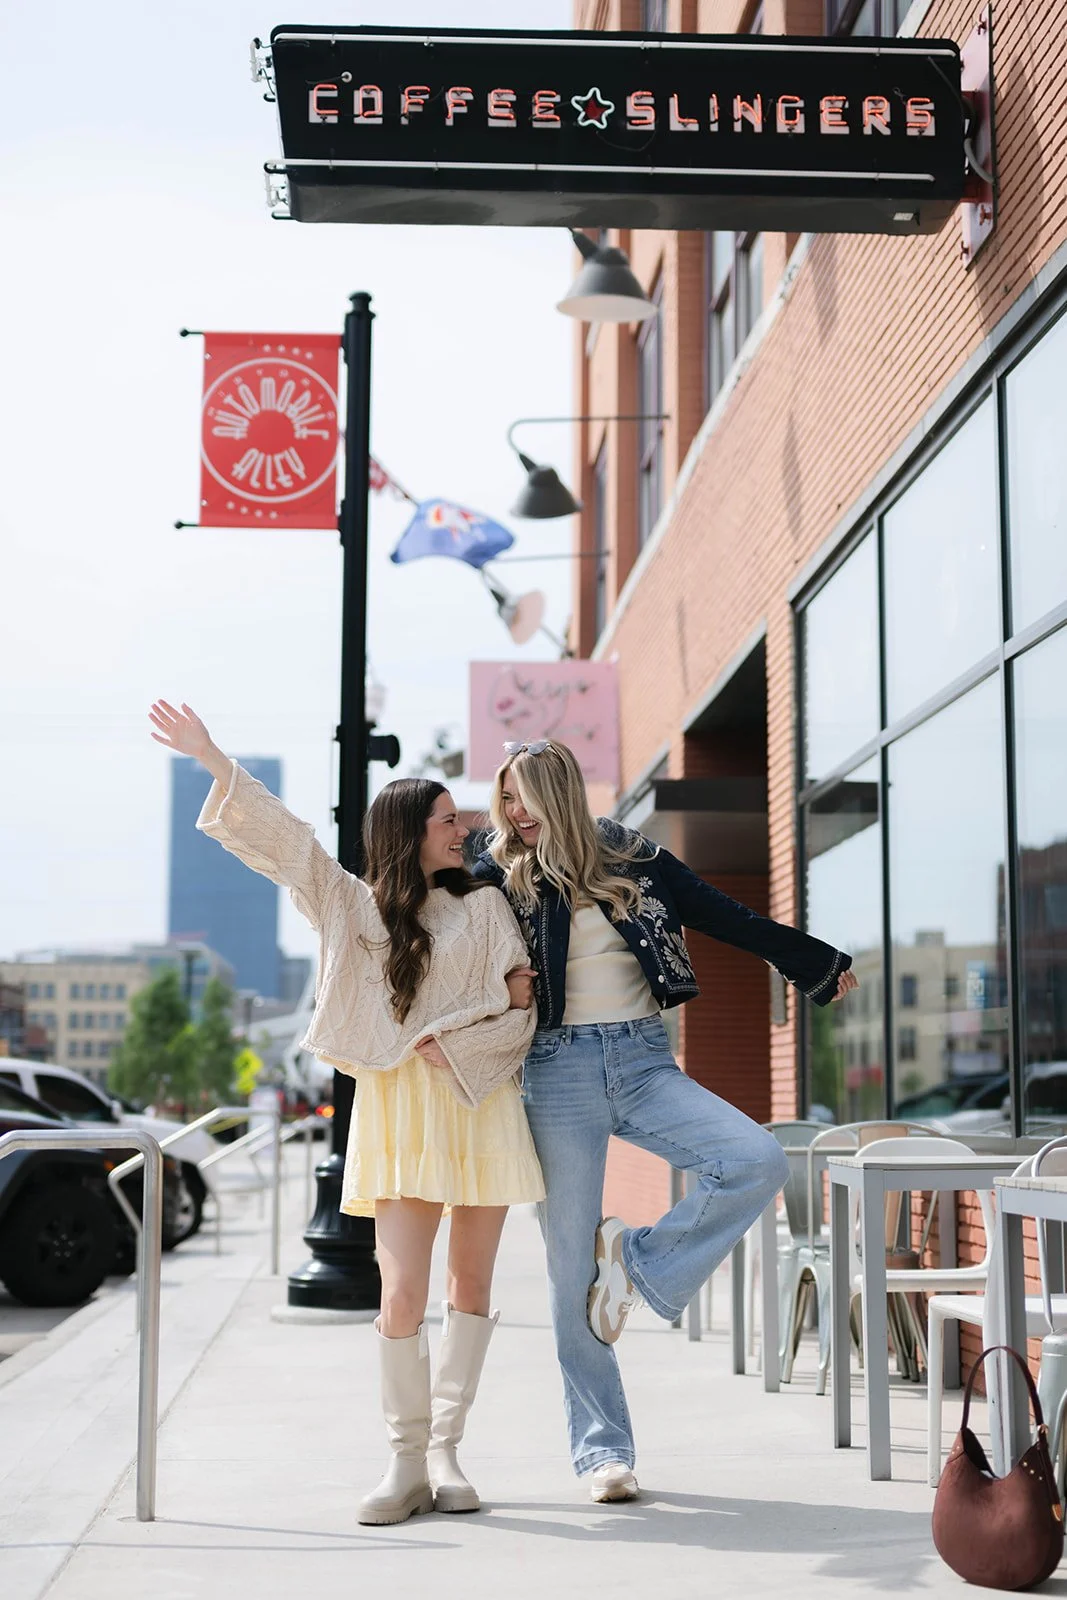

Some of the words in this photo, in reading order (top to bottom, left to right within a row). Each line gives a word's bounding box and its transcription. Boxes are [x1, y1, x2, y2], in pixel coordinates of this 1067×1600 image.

[308, 83, 562, 128] COFFEE
[626, 90, 937, 137] SLINGERS
[231, 447, 306, 490] ALLEY
